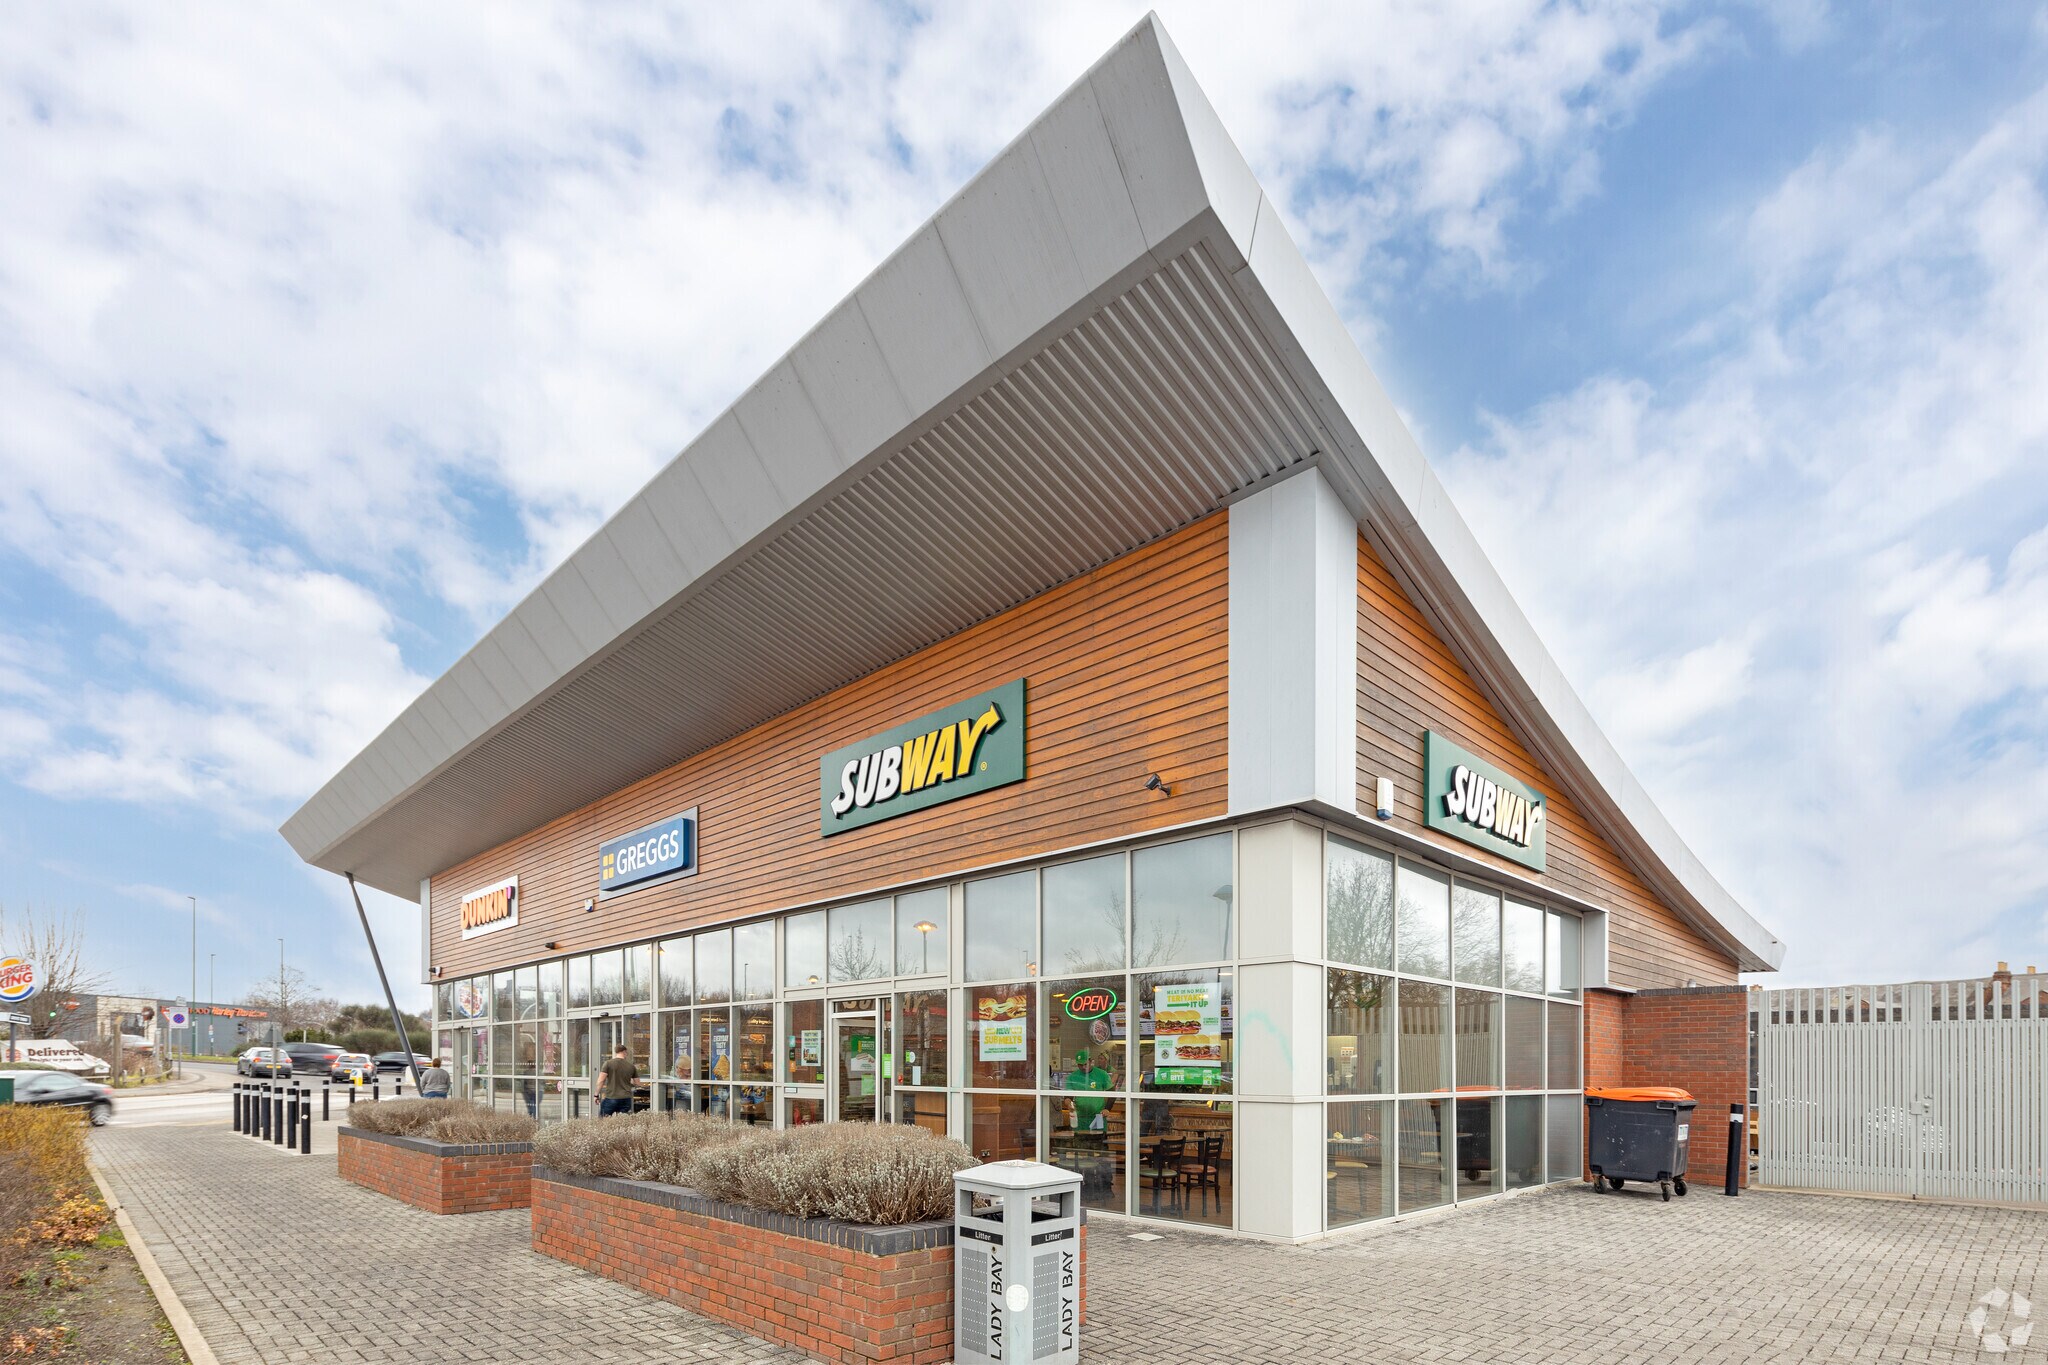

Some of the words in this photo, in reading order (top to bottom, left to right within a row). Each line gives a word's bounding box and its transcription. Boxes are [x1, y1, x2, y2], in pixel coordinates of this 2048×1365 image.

[831, 702, 1001, 819] SUBWAY
[1444, 765, 1543, 848] SUBWAY
[616, 829, 679, 875] GREGGS
[461, 885, 512, 930] DUNKIN'
[0, 964, 32, 976] URGER
[0, 972, 33, 989] KING
[1071, 995, 1109, 1012] OPEN
[1198, 1000, 1209, 1008] UP
[974, 1231, 991, 1241] Litter
[1045, 1232, 1062, 1242] Litter
[991, 1255, 1003, 1295] BAY
[1062, 1251, 1073, 1288] BAY
[991, 1302, 1002, 1361] LADY
[1061, 1297, 1073, 1351] LADY
